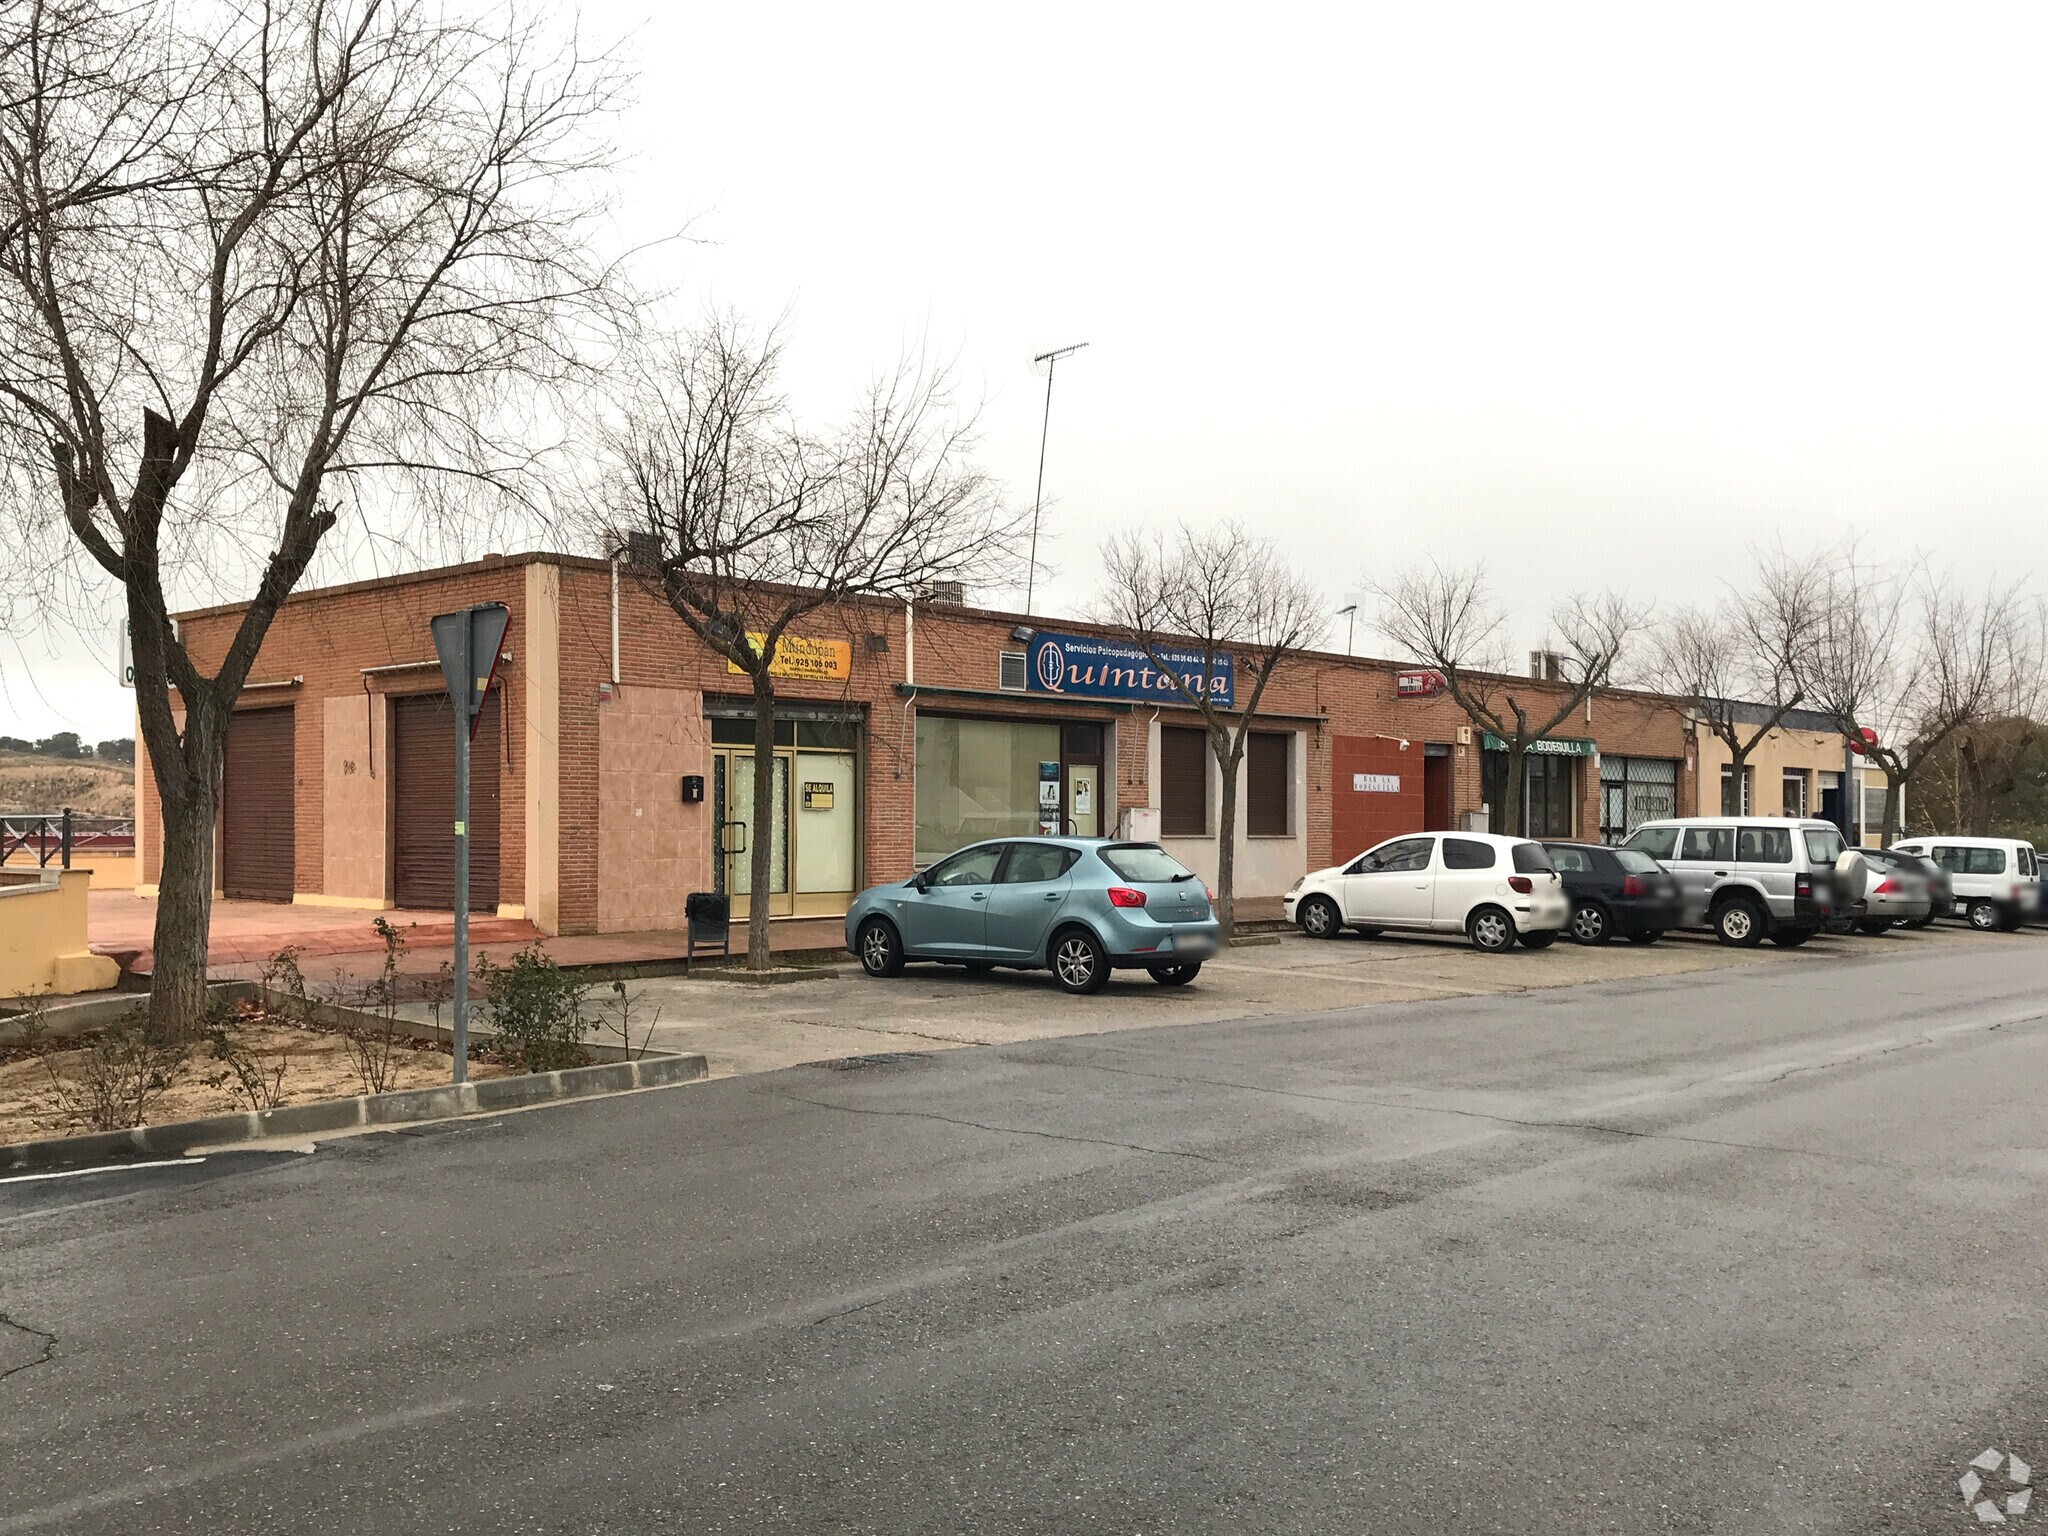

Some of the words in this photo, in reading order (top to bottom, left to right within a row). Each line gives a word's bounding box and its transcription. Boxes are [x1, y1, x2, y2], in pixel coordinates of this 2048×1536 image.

[1065, 643, 1097, 655] Servicios
[1098, 646, 1155, 660] Psicopedagógic
[780, 656, 793, 665] Tel.
[796, 659, 809, 667] 925
[825, 661, 838, 670] 003
[1037, 641, 1229, 694] Quintana
[1536, 740, 1582, 753] BODEGUILLA
[1363, 775, 1376, 783] BAR
[805, 783, 812, 793] SE
[812, 783, 833, 793] ALQUILA
